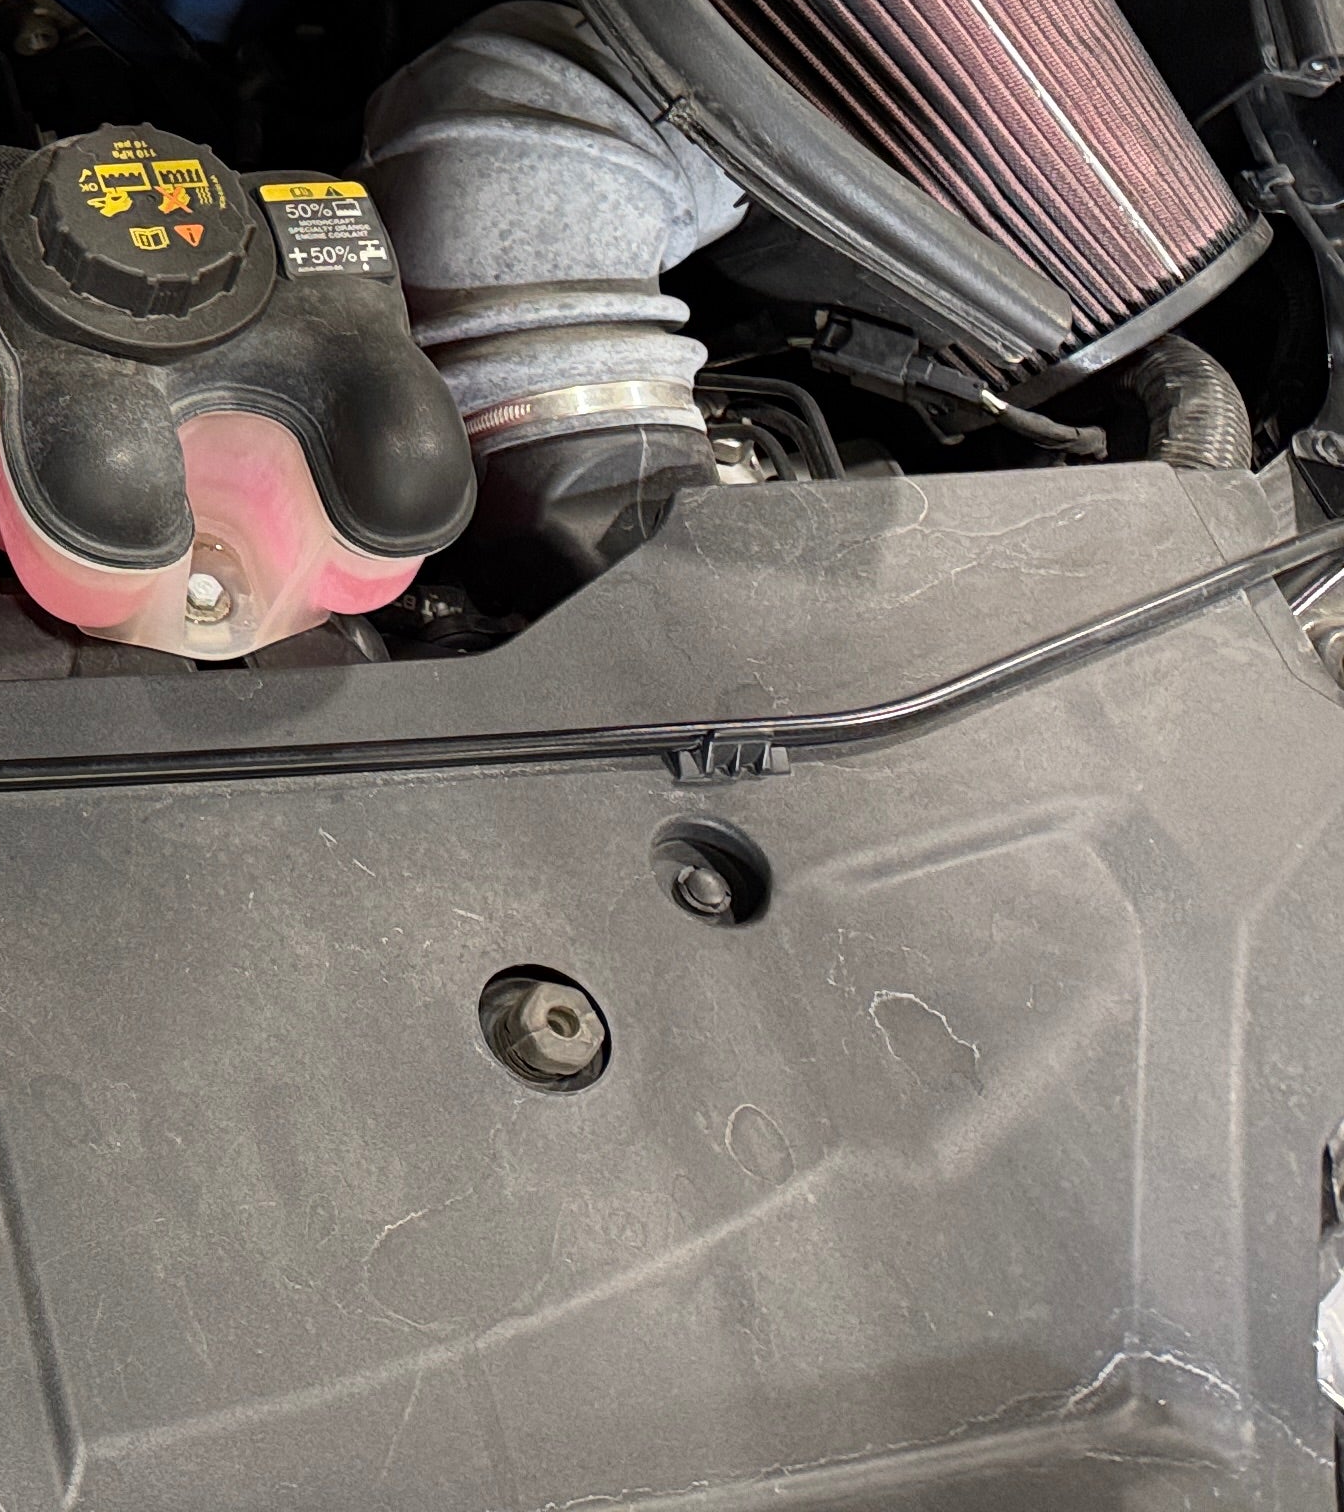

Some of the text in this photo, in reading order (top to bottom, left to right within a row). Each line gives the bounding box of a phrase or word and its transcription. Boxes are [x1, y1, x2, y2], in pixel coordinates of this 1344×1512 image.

[112, 148, 157, 159] 110 kPa
[79, 182, 99, 192] OK
[285, 202, 333, 219] 50%
[298, 217, 355, 226] MOTORCRAFT
[288, 226, 333, 235] SPECIALTY
[328, 230, 368, 239] COOLANT
